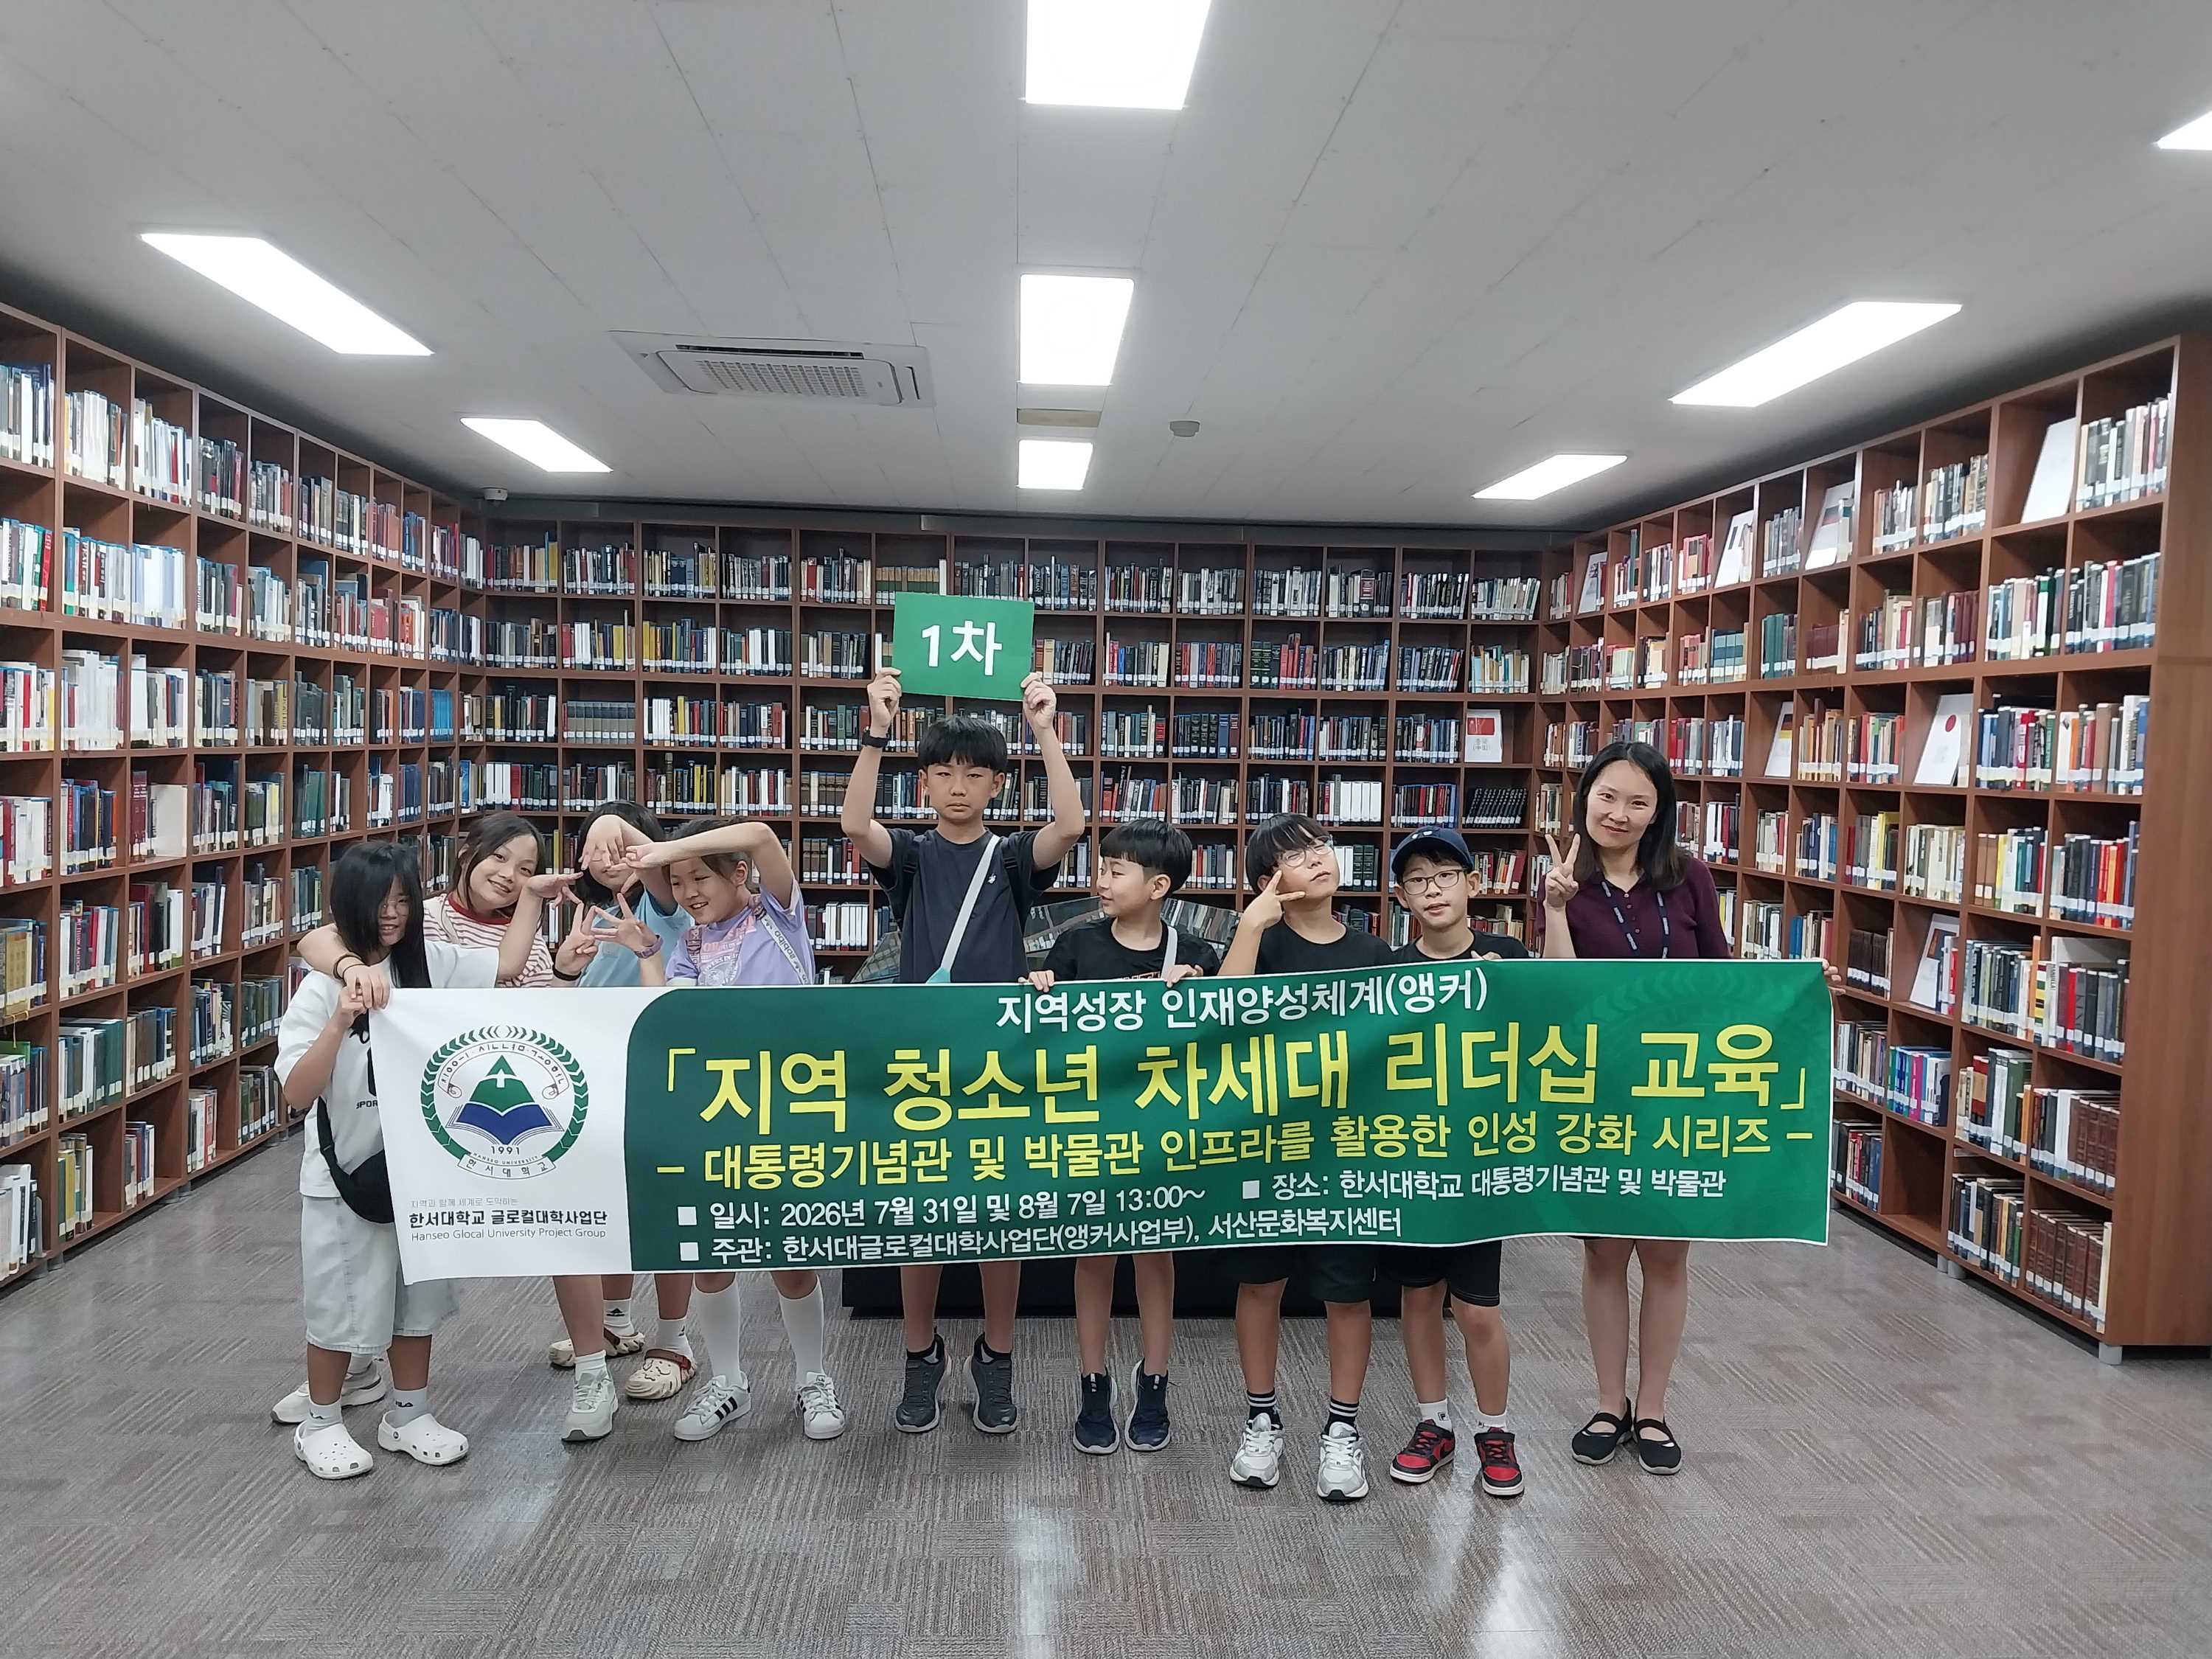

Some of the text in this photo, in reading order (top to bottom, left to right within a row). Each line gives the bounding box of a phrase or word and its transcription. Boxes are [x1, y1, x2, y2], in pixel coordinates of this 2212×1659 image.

[922, 620, 1003, 676] 1차
[996, 967, 1488, 1034] 지역성장 인재양성체계(앵커)
[883, 1048, 1100, 1131] 청소년
[1134, 1029, 1349, 1120] 차세대
[1386, 1022, 1598, 1106] 리더십
[466, 1158, 549, 1178] 한서대학교
[491, 1146, 520, 1155] 1991
[705, 1138, 953, 1189] 대통령기념관
[970, 1136, 1006, 1181] 및
[1024, 1131, 1144, 1178] 박물관
[1161, 1121, 1315, 1171] 인프라를
[1330, 1114, 1452, 1158] 활용한
[1468, 1111, 1538, 1157] 인성
[1557, 1113, 1637, 1156] 강화
[1652, 1116, 1771, 1158] 시리즈
[1271, 1164, 1727, 1201] 장소: 한서대학교 대통령기념관 및 박물관
[409, 1209, 608, 1228] 한서대학교 글로컬대학사업단
[709, 1185, 1206, 1229] 일시: 2026년 7월 31일 및 8월 7일 13:00~
[411, 1228, 607, 1241] Hanseo Glocal University Project Group
[710, 1237, 772, 1264] 주관:
[1207, 1207, 1402, 1240] 서산문화복지센터
